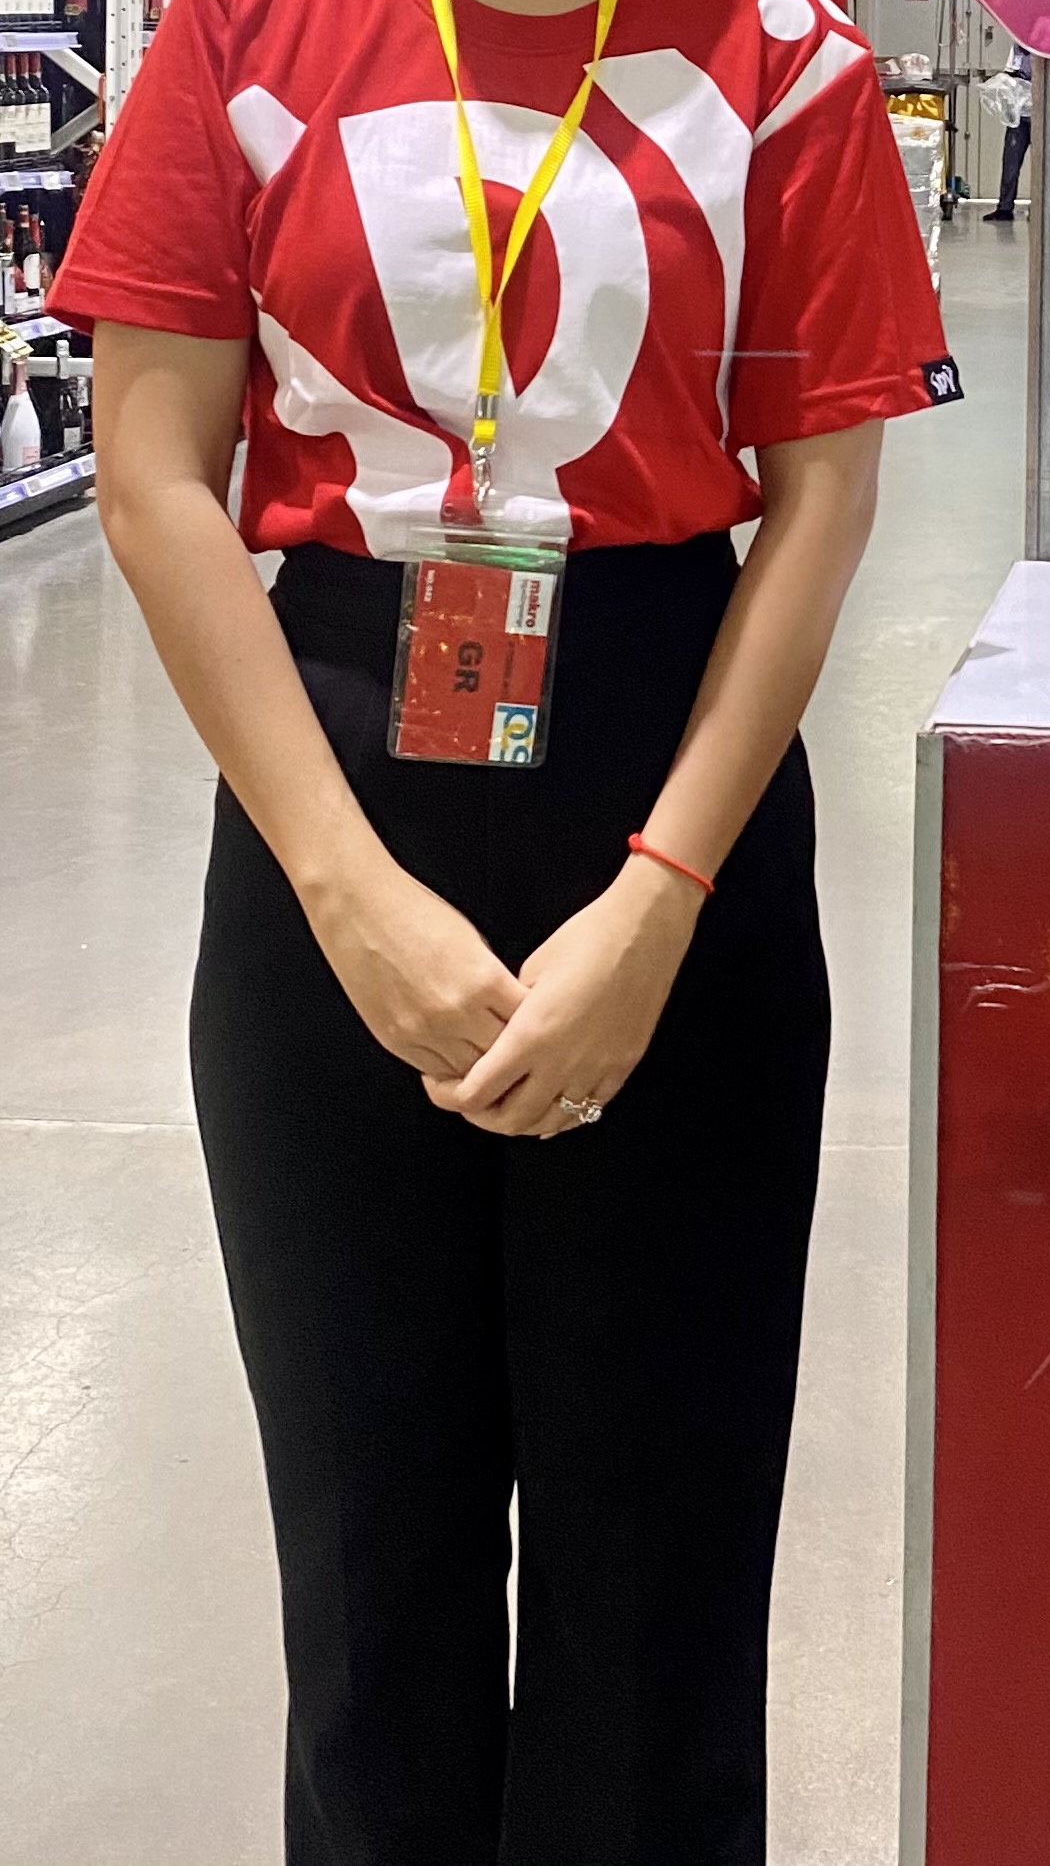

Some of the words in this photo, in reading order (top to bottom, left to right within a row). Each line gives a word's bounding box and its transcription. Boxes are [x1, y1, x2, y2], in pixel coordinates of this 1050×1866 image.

[930, 364, 957, 396] SPY
[525, 580, 541, 628] makro
[454, 641, 483, 693] GR
